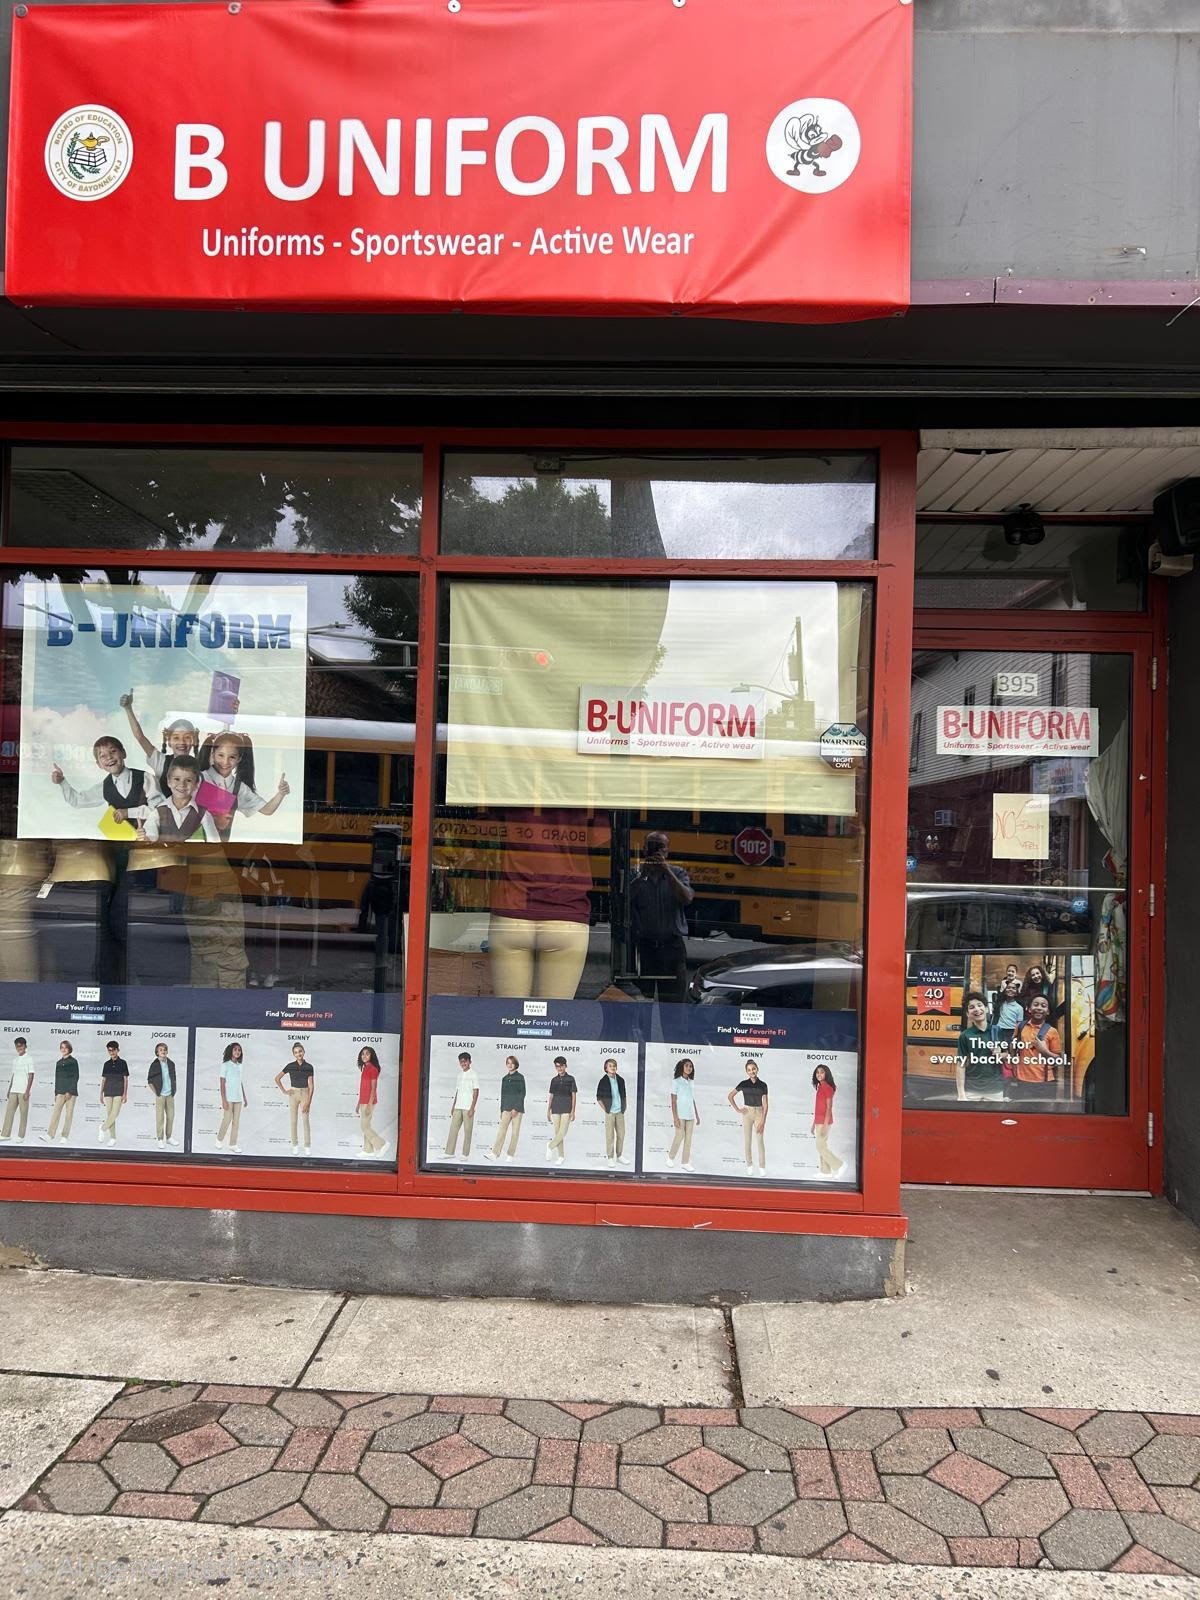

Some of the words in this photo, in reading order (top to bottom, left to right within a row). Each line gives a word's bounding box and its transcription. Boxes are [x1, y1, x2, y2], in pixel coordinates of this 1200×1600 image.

[54, 120, 74, 145] BOARD
[75, 115, 86, 123] OF
[87, 114, 123, 145] EDUCATION
[174, 123, 228, 201] B
[264, 113, 728, 201] UNIFORM
[54, 161, 68, 181] CITY
[67, 180, 77, 190] OF
[114, 159, 123, 173] NJ
[201, 226, 325, 257] Uniforms
[350, 226, 504, 262] Sportswear
[529, 225, 614, 257] Active
[622, 226, 695, 256] Wear
[47, 612, 292, 649] B-UNIFORM
[998, 675, 1035, 693] 395
[587, 699, 756, 738] B-UNIFORM
[943, 709, 1091, 741] B-UNIFORM
[587, 736, 629, 746] Uniforms
[637, 738, 690, 748] Sportswear
[700, 740, 730, 749] Active
[822, 738, 866, 747] WARNING
[943, 741, 981, 749] Uniforms
[987, 742, 1034, 750] Sportswear
[924, 988, 944, 1000] 40
[85, 1004, 112, 1012] Favorite
[296, 1011, 323, 1019] Favorite
[532, 1019, 559, 1027] Favorite
[50, 1028, 80, 1036] STRAIGHT
[113, 1030, 132, 1038] TAPER
[749, 1027, 776, 1035] Favorite
[447, 1041, 475, 1049] RELAXED
[496, 1043, 527, 1051] STRAIGHT
[969, 1037, 1009, 1050] There
[1011, 1037, 1031, 1050] for
[560, 1045, 580, 1053] TAPER
[670, 1047, 702, 1055] STRAIGHT
[740, 1051, 763, 1059] SKINNY
[930, 1055, 967, 1068] every
[970, 1053, 1003, 1065] back
[1006, 1054, 1020, 1065] to
[1023, 1053, 1072, 1066] school.
